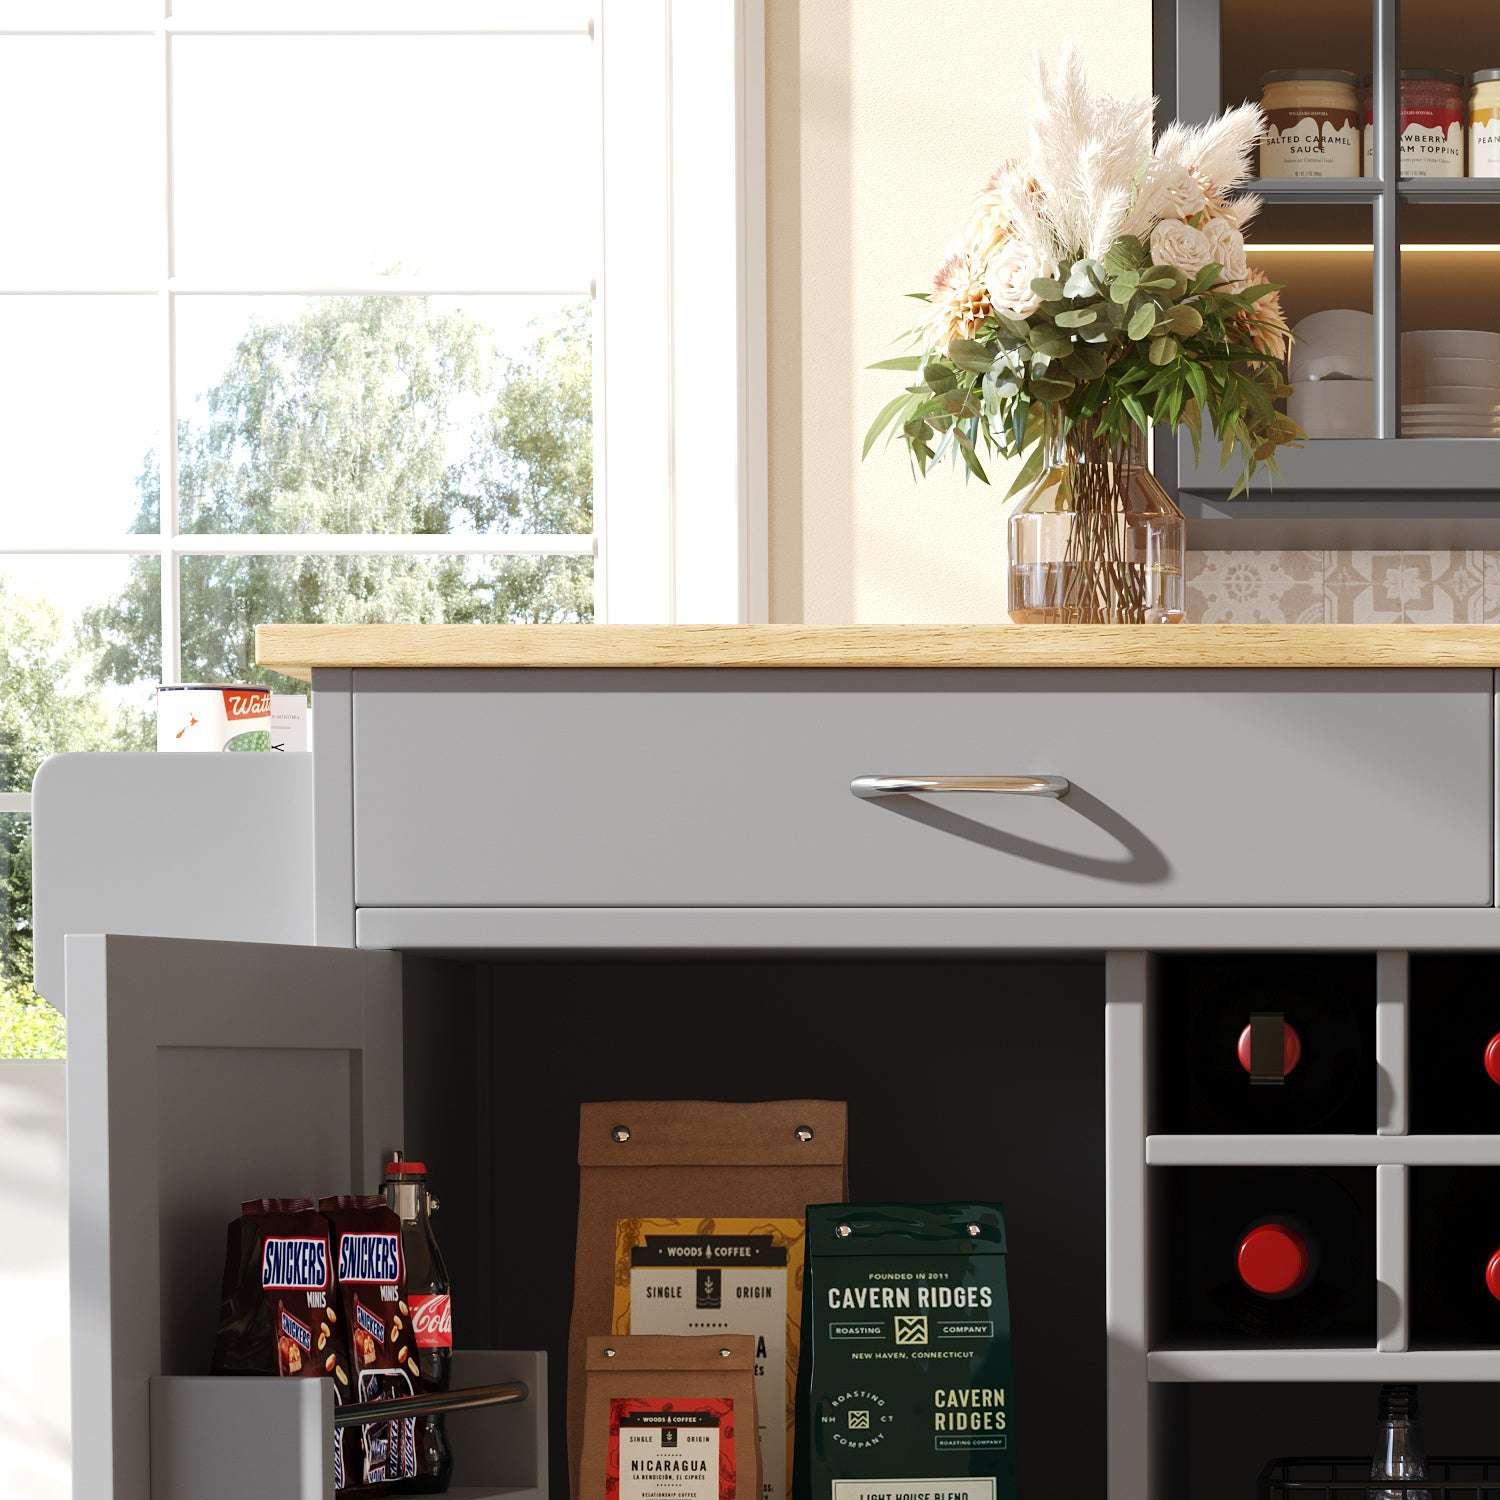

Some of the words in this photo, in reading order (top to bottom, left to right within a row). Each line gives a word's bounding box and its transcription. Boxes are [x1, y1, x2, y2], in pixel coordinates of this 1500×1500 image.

[1267, 136, 1299, 145] SALTED
[1306, 136, 1351, 145] CARAMEL
[1421, 146, 1459, 156] TOPPING
[339, 1235, 398, 1281] SNICKERS
[667, 1247, 702, 1257] WOODS
[714, 1247, 752, 1257] COFFEE
[264, 1239, 327, 1286] SNICKERS
[307, 1292, 327, 1308] MINIS
[380, 1286, 398, 1302] MINIS
[646, 1287, 682, 1298] SINGLE
[736, 1287, 772, 1298] ORIGIN
[828, 1287, 910, 1309] CAVERN
[918, 1286, 992, 1309] RIDGES
[281, 1312, 311, 1349] SNICKERS
[356, 1305, 385, 1343] SNICKERS
[832, 1391, 885, 1407] ROASTING
[935, 1388, 1005, 1408] CAVERN
[935, 1412, 1006, 1431] RIDGES
[833, 1433, 884, 1449] COMPANY
[631, 1460, 707, 1472] NICARAGUA
